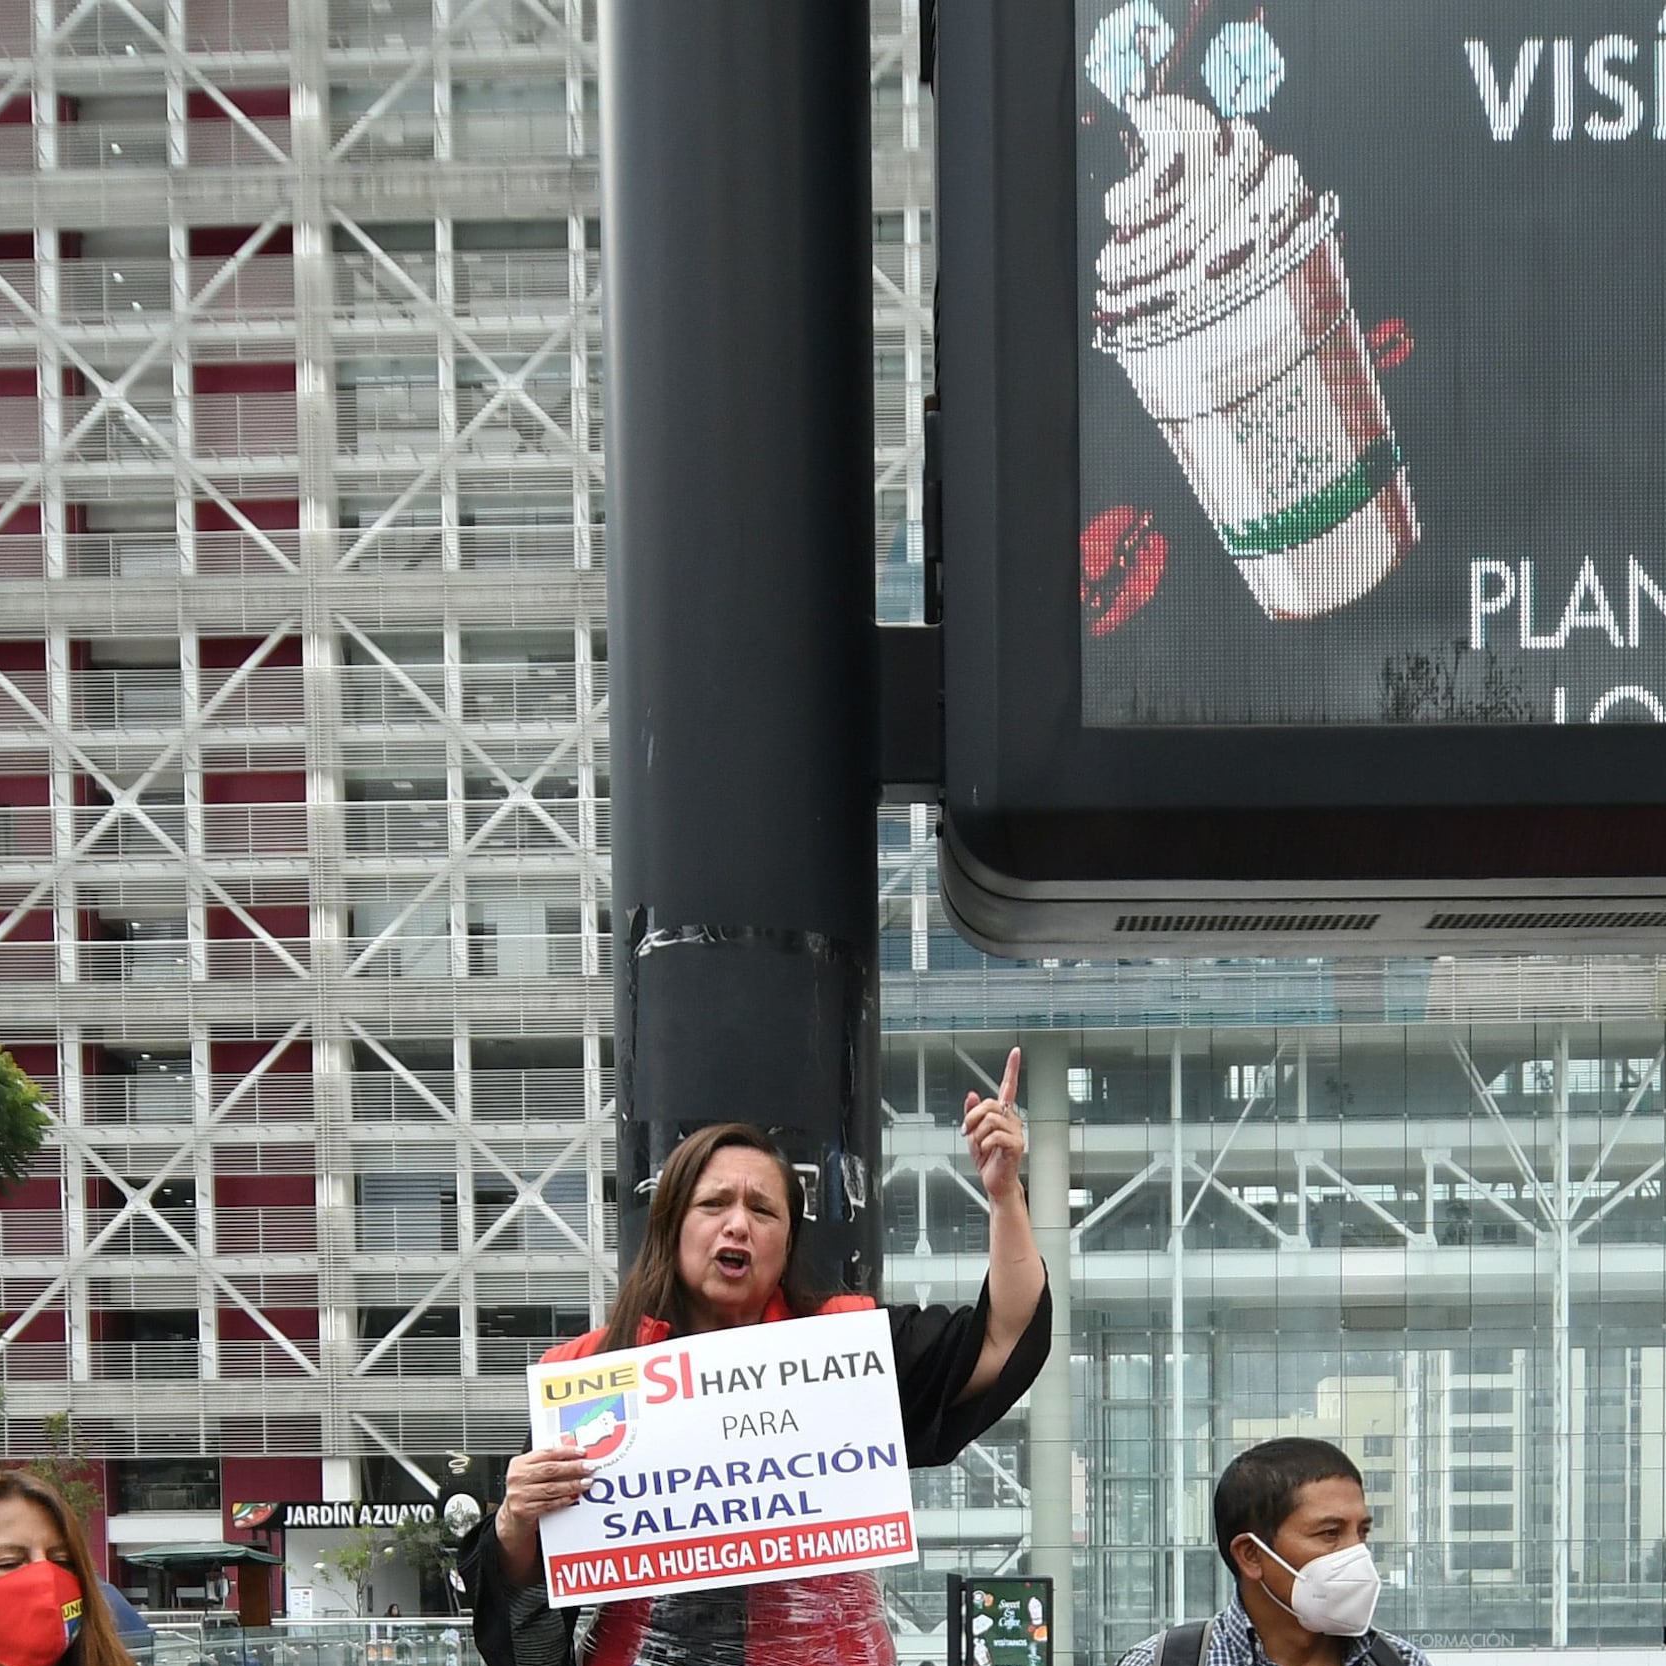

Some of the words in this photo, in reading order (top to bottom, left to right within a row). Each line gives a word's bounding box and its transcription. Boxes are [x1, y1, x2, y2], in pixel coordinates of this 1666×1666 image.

[545, 1367, 635, 1401] UNE
[643, 1351, 695, 1404] SI
[700, 1363, 767, 1396] HAY
[779, 1350, 885, 1386] PLATA
[722, 1408, 799, 1440] PARA
[568, 1442, 897, 1506] QUIPARACIÓN
[283, 1502, 354, 1526] JARDÍN
[358, 1503, 435, 1526] AZUAYO
[603, 1490, 823, 1539] SALARIAL
[555, 1558, 620, 1596] ¡VIVA
[623, 1554, 655, 1581] LA
[658, 1541, 757, 1577] HUELGA
[759, 1536, 793, 1564] DE
[797, 1520, 907, 1559] HAMBRE!
